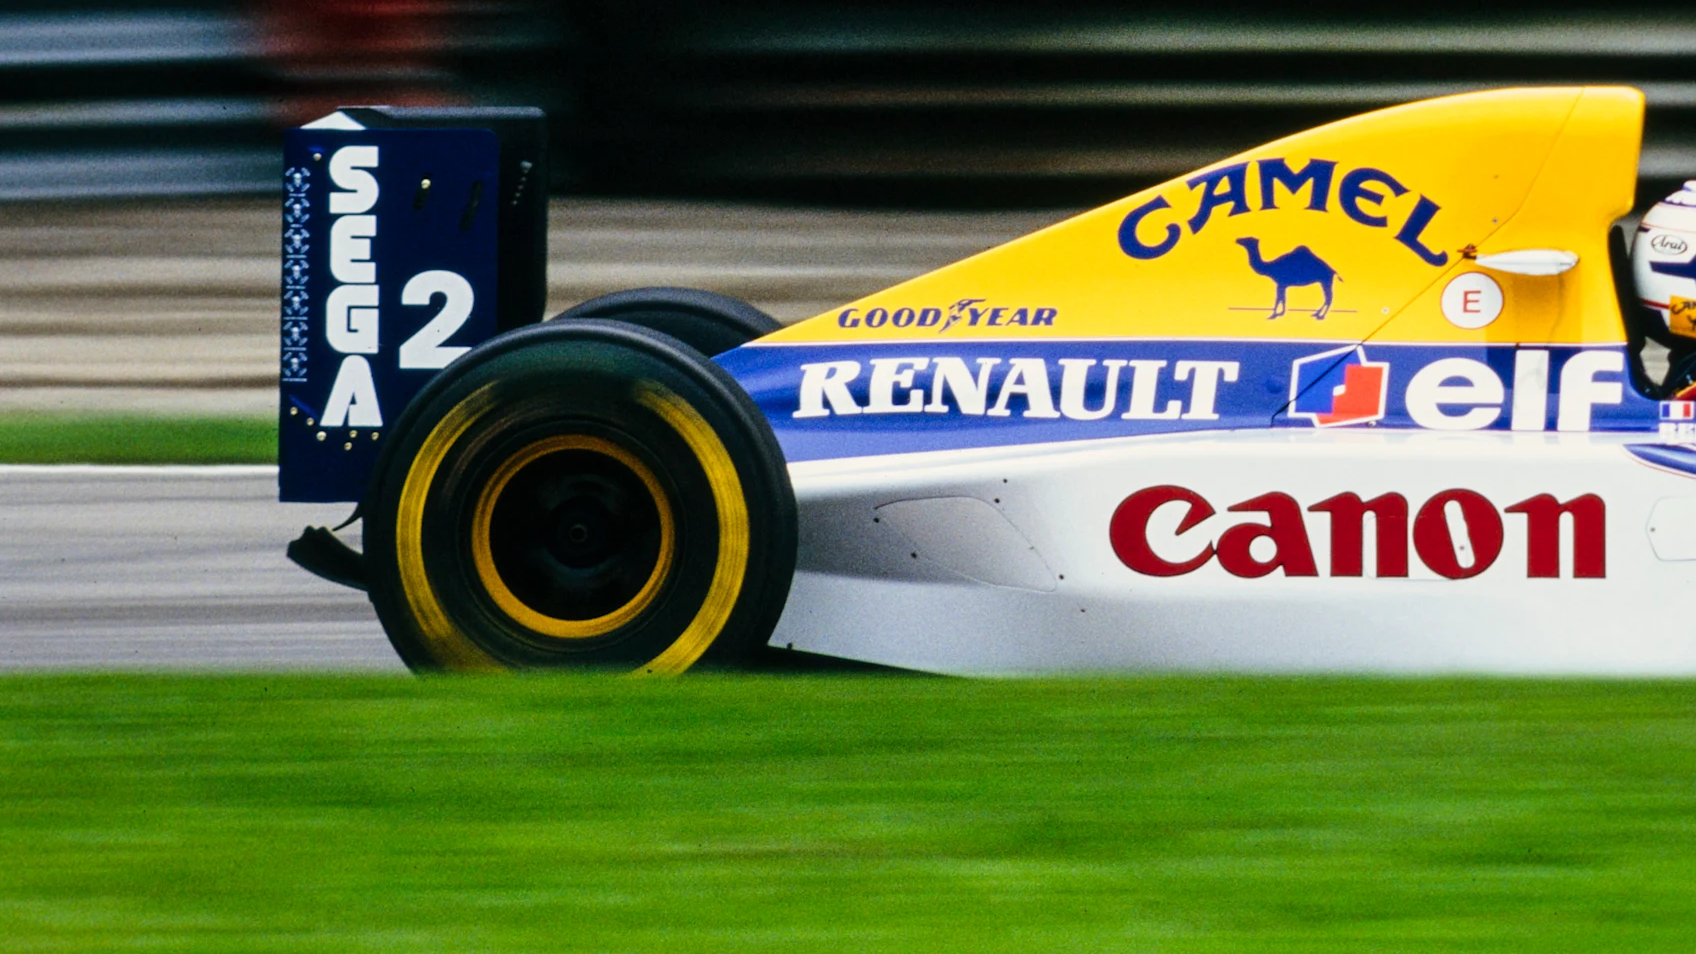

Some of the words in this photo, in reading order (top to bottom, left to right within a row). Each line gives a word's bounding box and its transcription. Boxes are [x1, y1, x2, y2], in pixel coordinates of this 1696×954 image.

[1117, 157, 1449, 267] CAMEL
[320, 145, 383, 426] SEGA
[399, 270, 475, 369] 2
[1463, 290, 1482, 313] E
[792, 357, 1240, 421] RENAULT
[1405, 349, 1625, 432] elf
[1109, 484, 1606, 580] Canon
